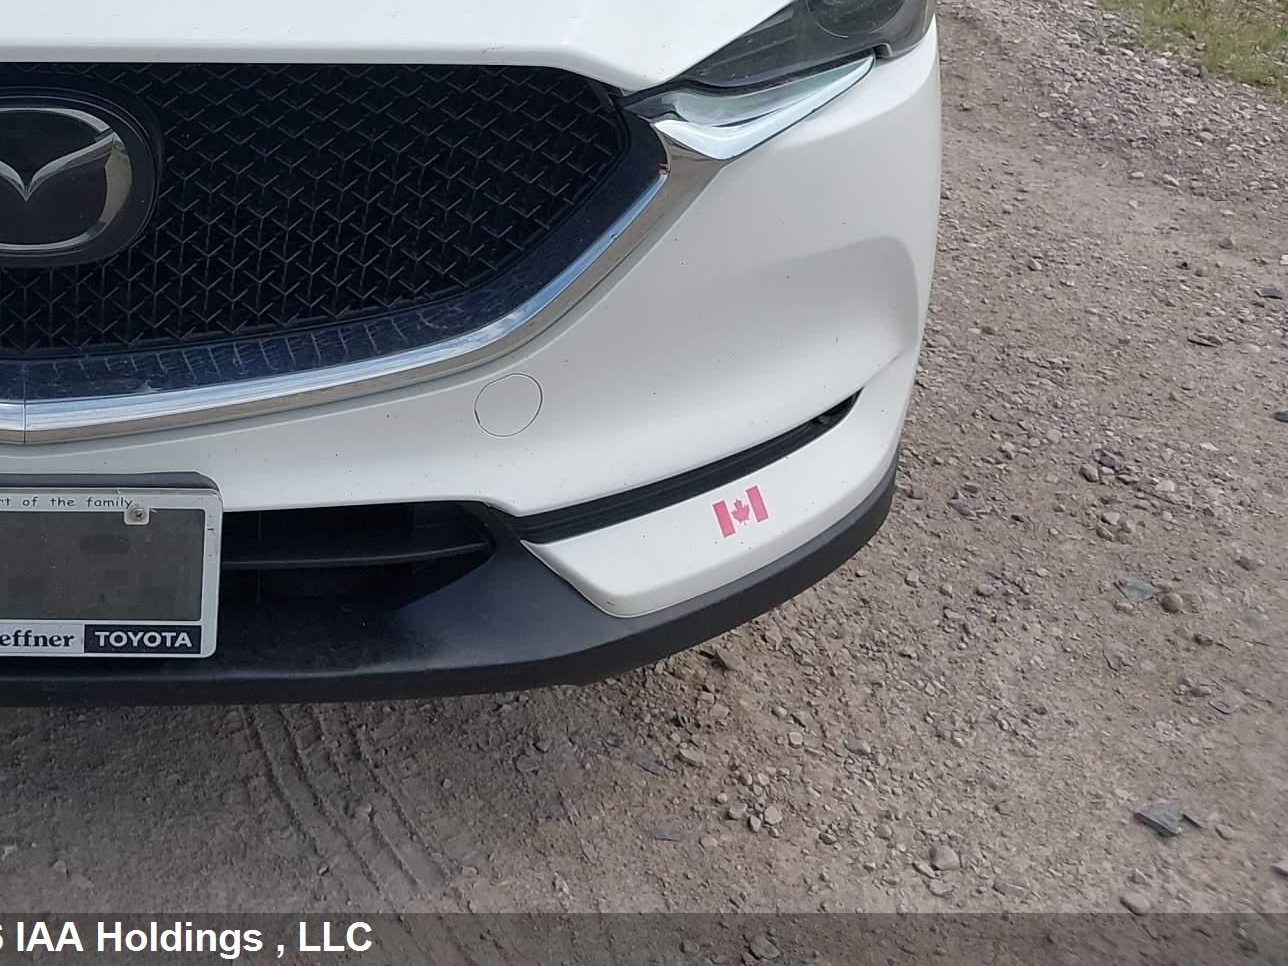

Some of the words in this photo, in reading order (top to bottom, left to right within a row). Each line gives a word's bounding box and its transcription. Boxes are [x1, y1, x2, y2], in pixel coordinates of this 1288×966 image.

[21, 495, 41, 508] of
[49, 496, 76, 508] the
[94, 630, 193, 648] TOYOTA
